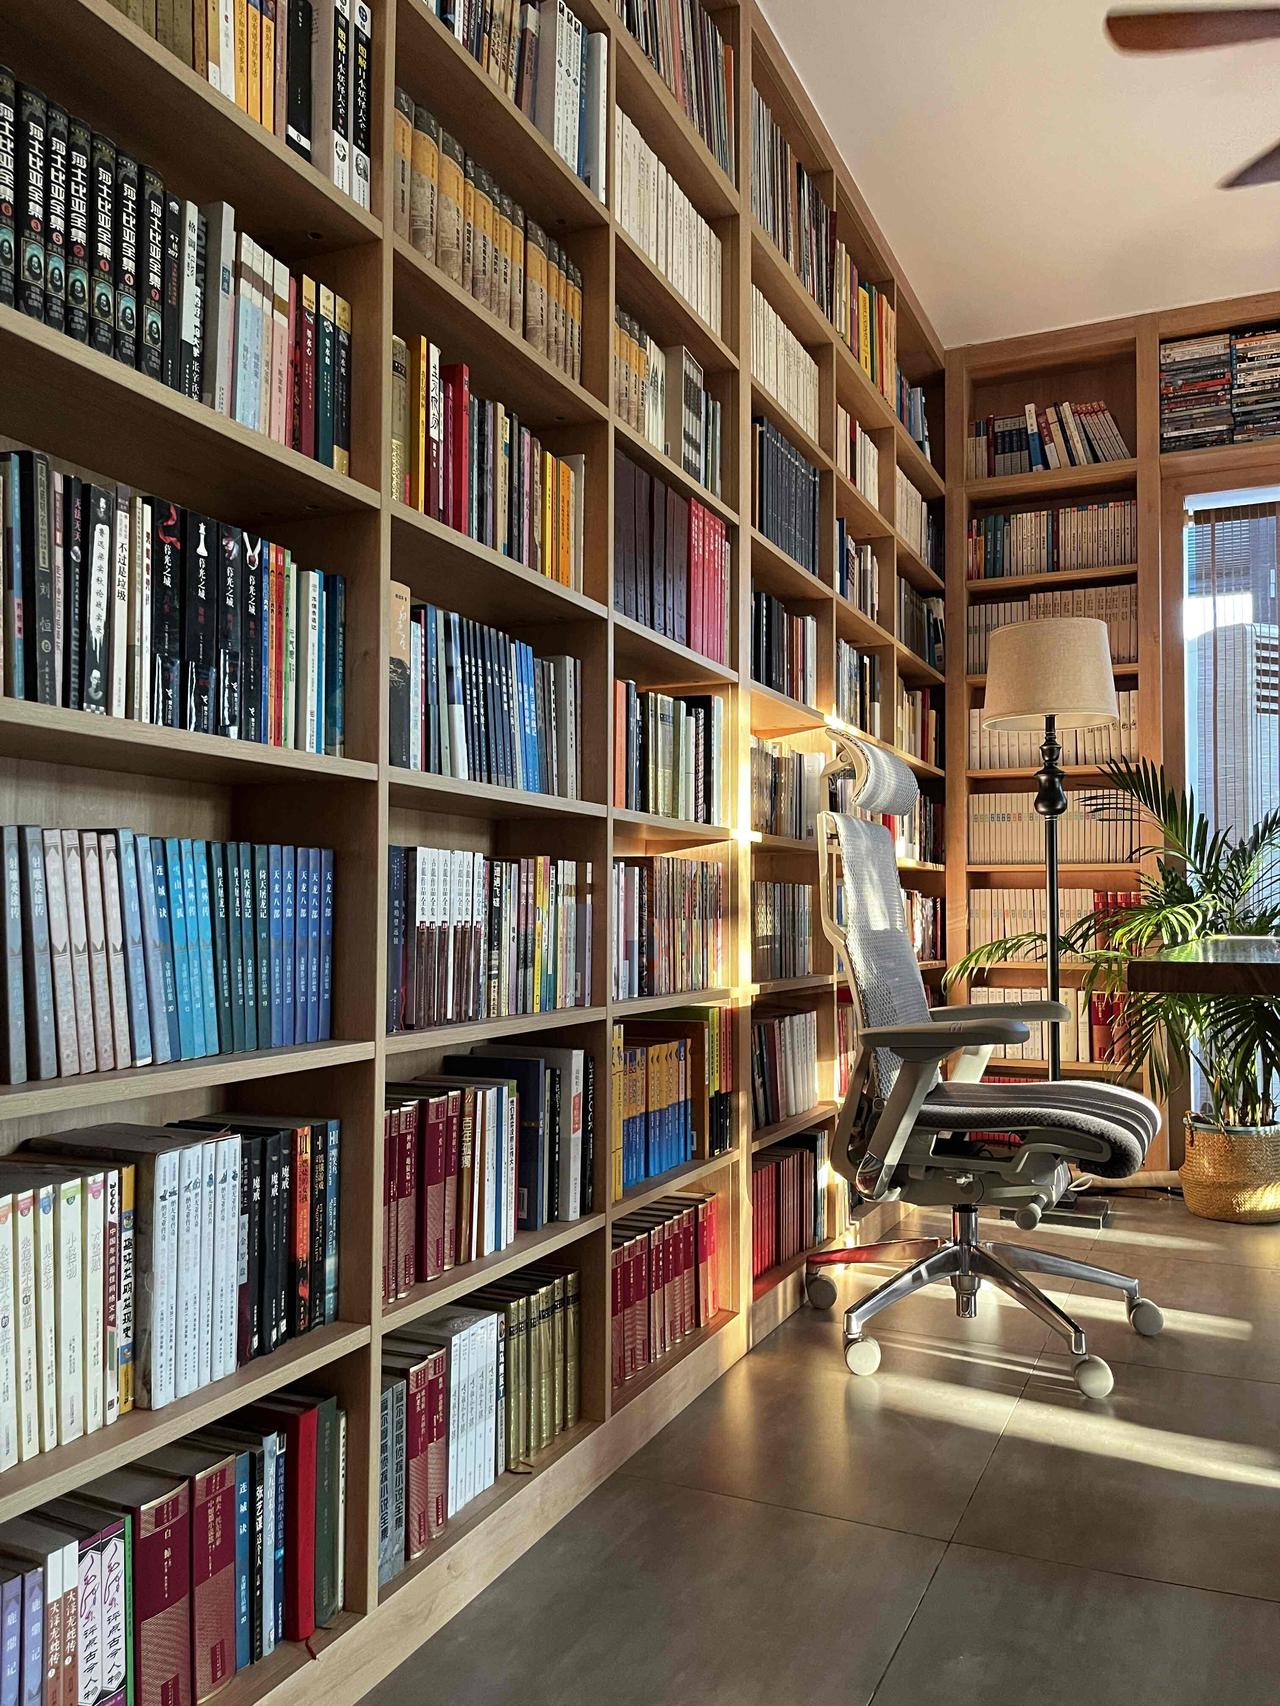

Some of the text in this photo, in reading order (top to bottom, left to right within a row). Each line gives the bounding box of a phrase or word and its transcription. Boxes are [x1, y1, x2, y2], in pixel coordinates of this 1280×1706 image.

[0, 102, 14, 205] 莎士比亚全集
[29, 121, 44, 221] 莎士比亚全集
[50, 137, 66, 233] 莎士比亚全集
[70, 151, 87, 247] 莎士比亚全集
[97, 167, 112, 262] 莎士比亚全集
[121, 183, 136, 276] 莎士比亚全集
[149, 199, 162, 291] 莎士比亚全集
[117, 543, 127, 601] 不过是垃圾
[162, 544, 172, 588] 暮光之城
[198, 557, 206, 600] 暮光之城
[226, 566, 234, 607] 暮光之城
[248, 575, 256, 615] 暮光之城
[259, 869, 267, 919] 倚天屠龙记
[252, 1176, 260, 1201] 魔戒
[271, 1172, 278, 1197] 魔戒
[281, 1165, 289, 1189] 魔戒
[239, 1482, 247, 1535] 连城诀
